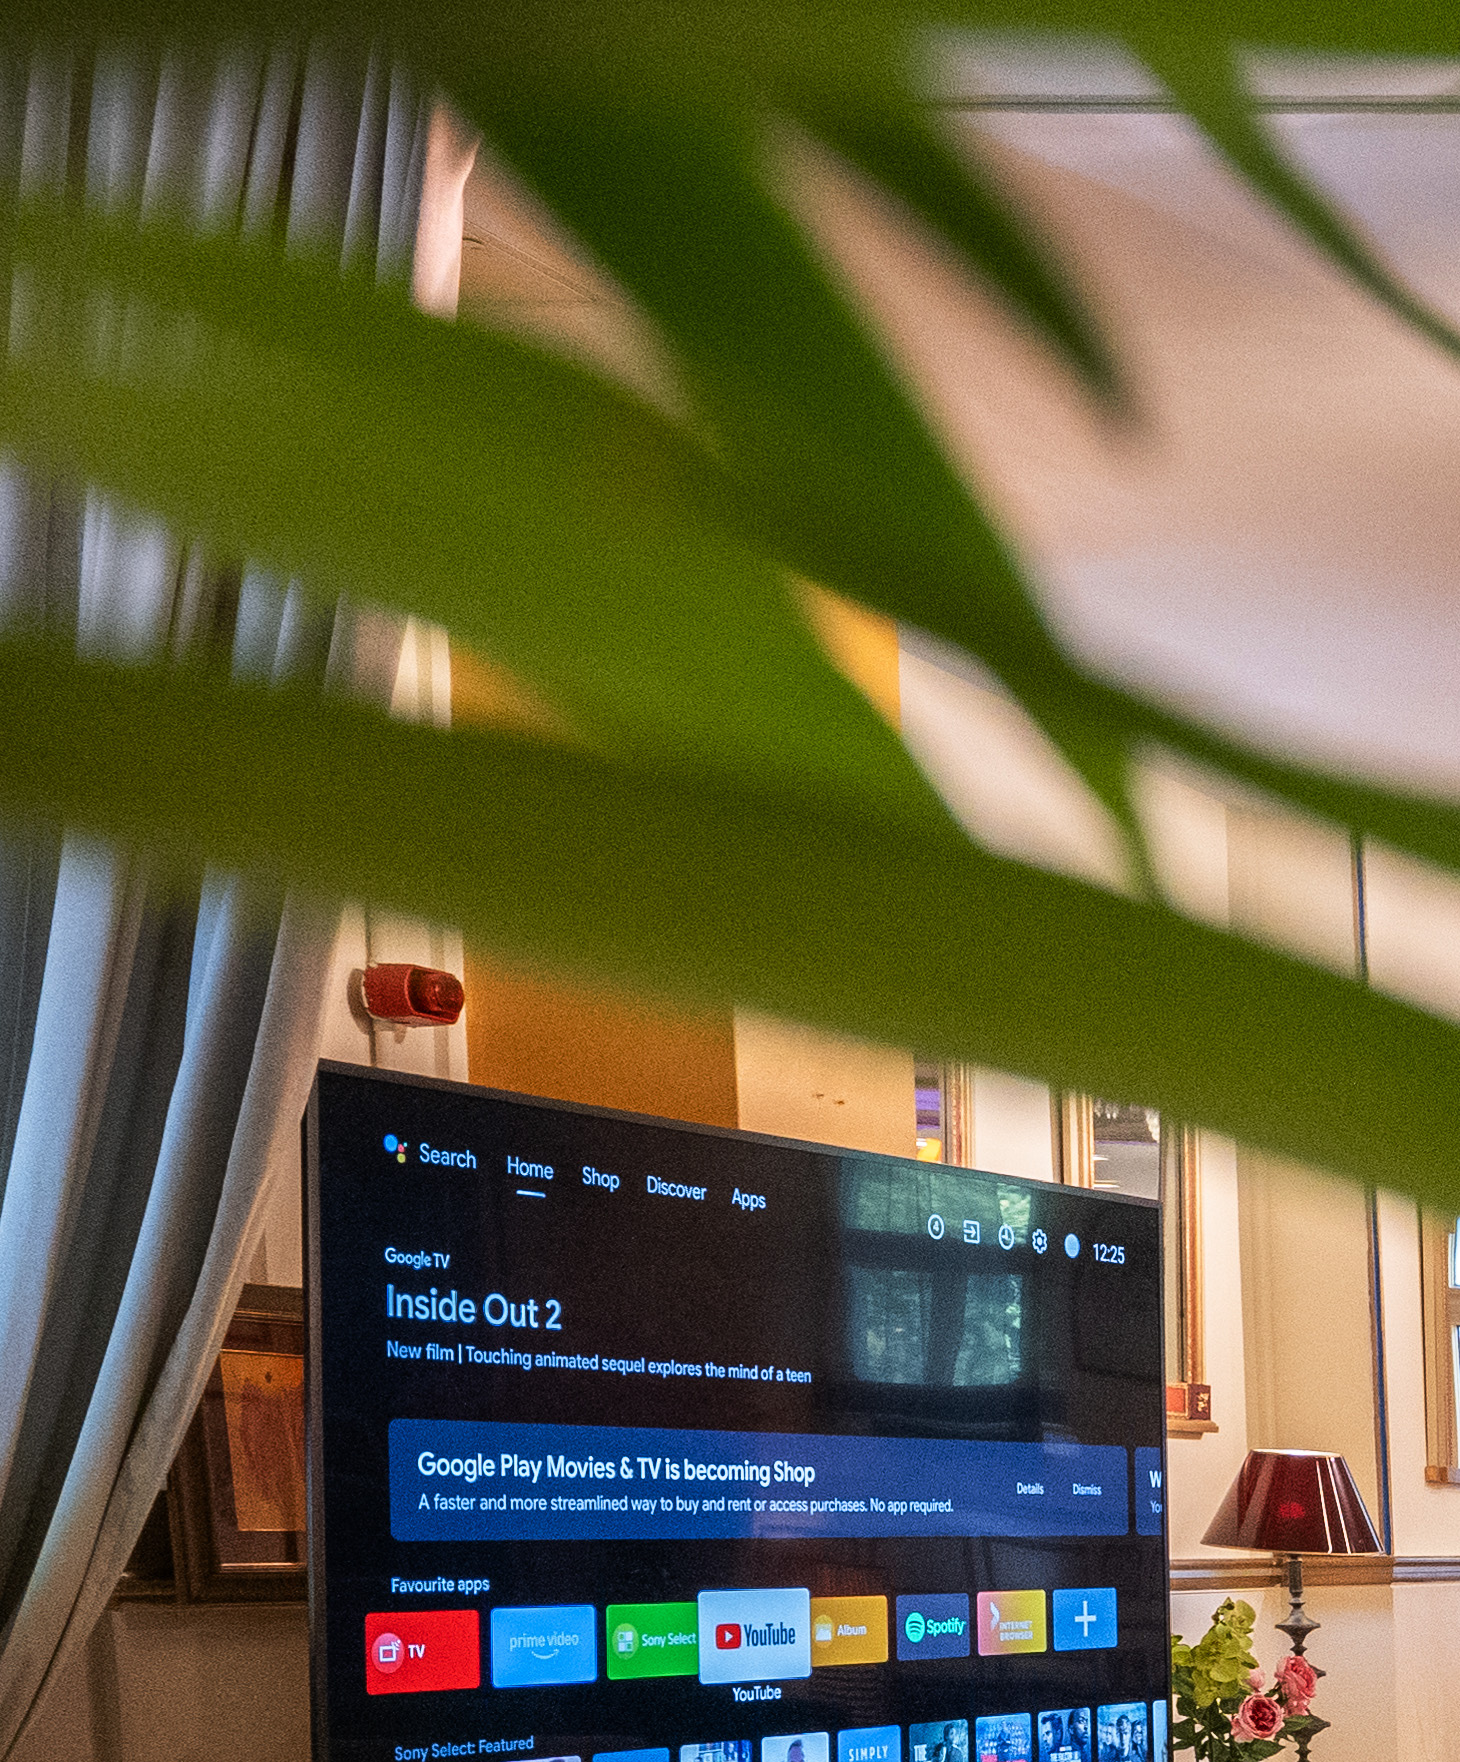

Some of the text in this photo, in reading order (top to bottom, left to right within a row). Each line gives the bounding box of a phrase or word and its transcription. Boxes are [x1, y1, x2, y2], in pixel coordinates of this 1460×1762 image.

[419, 1143, 477, 1169] Search
[507, 1155, 554, 1180] Home
[582, 1165, 620, 1192] Shop
[647, 1175, 707, 1200] Discover
[732, 1187, 767, 1212] Apps
[385, 1247, 450, 1270] Google TV
[1093, 1243, 1125, 1264] 12:25
[387, 1284, 562, 1330] Inside Out 2
[387, 1340, 422, 1359] New
[426, 1343, 454, 1361] film
[466, 1346, 532, 1371] Touching
[535, 1352, 599, 1371] animated
[602, 1357, 645, 1376] sequel
[648, 1359, 702, 1378] explores
[705, 1362, 726, 1378] the
[728, 1364, 758, 1380] mind
[760, 1365, 774, 1380] of
[776, 1369, 784, 1382] a
[786, 1368, 812, 1383] teen
[418, 1451, 815, 1487] Google Play Movies & TV is becoming Shop
[1016, 1482, 1045, 1495] Details
[1072, 1483, 1102, 1496] Dismiss
[418, 1493, 954, 1516] A faster and more streamlined way to buy and rent or access purchases. No app required.
[391, 1577, 490, 1595] Favourite apps
[743, 1622, 796, 1647] YouTube
[837, 1624, 867, 1636] Album
[926, 1617, 966, 1637] Spotify
[509, 1631, 579, 1651] prime video
[641, 1631, 697, 1648] Sony Select
[408, 1644, 425, 1659] TV
[732, 1685, 782, 1702] YouTube
[394, 1735, 534, 1762] Sony Select: Featured
[848, 1745, 889, 1762] SIMPLY
